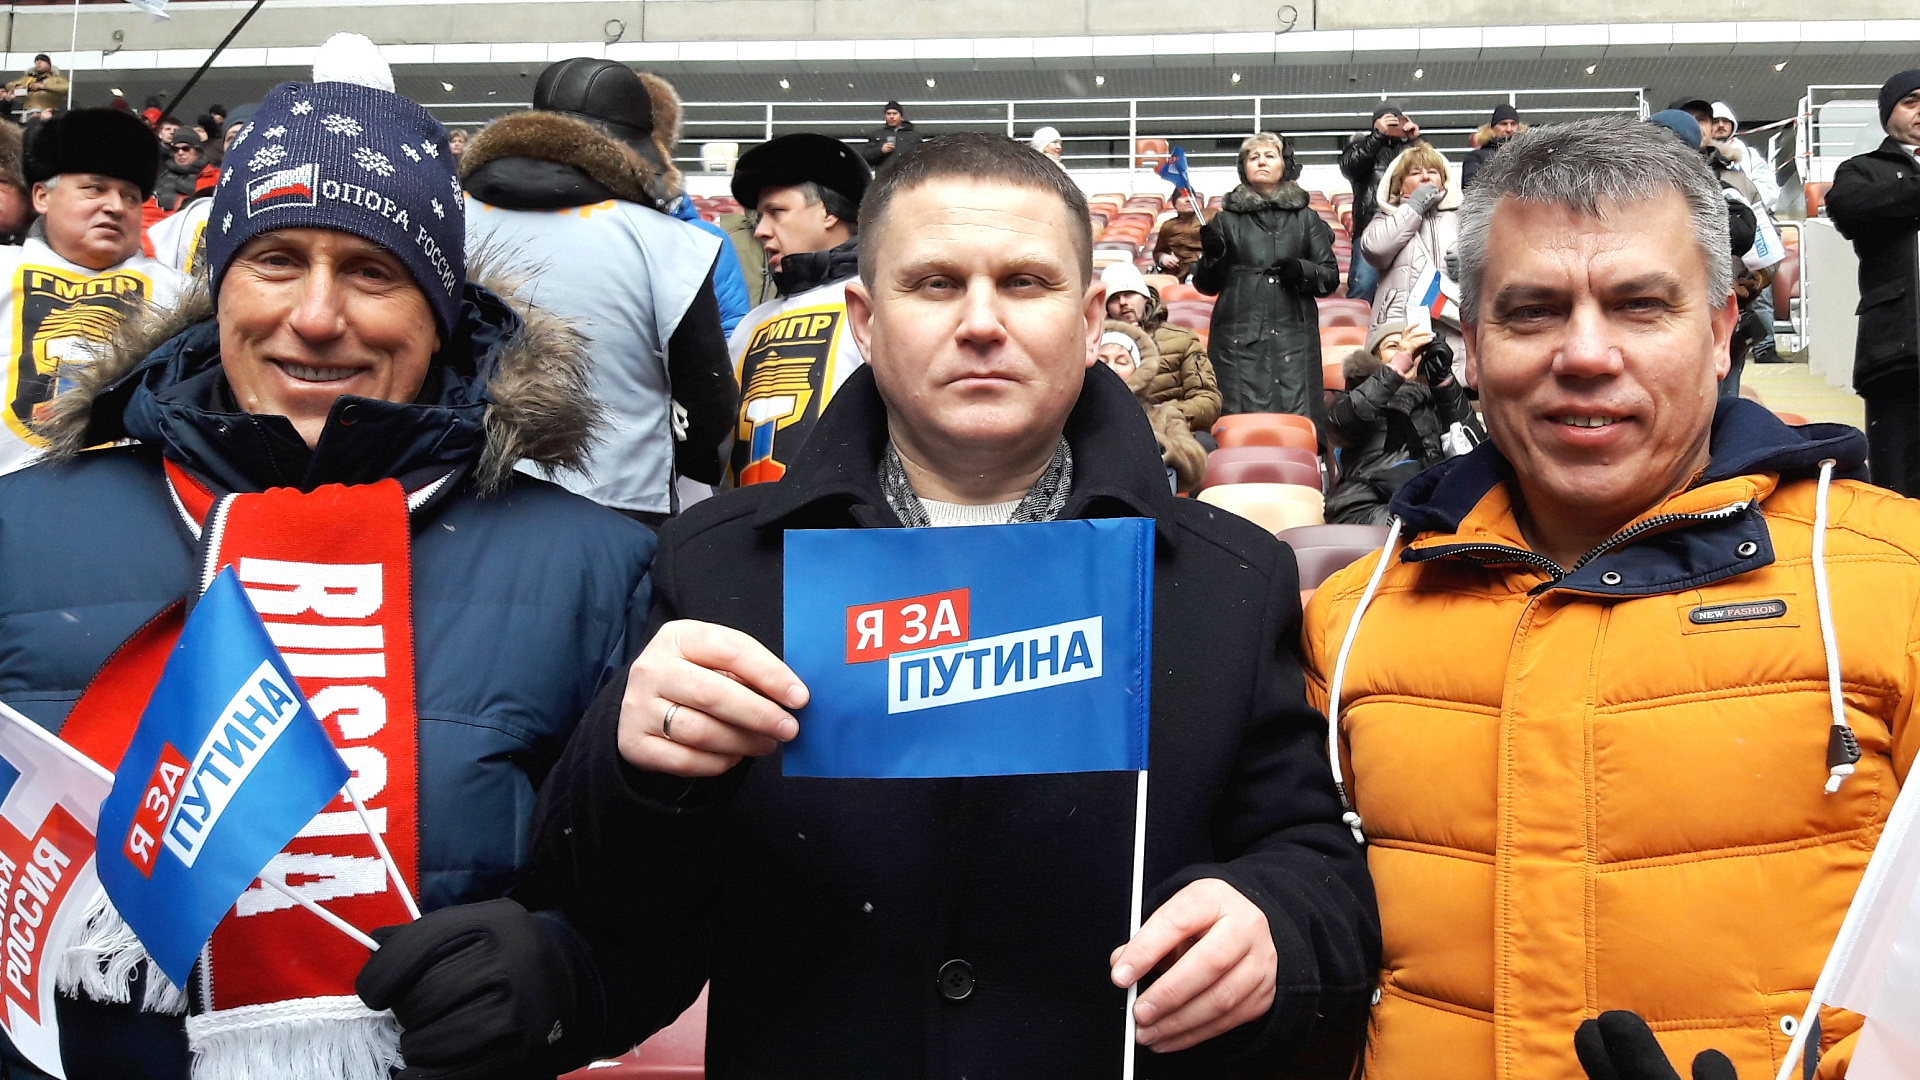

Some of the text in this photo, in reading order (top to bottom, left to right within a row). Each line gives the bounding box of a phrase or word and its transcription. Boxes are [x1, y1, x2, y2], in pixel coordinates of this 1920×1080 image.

[322, 179, 410, 232] ОПОРА
[414, 224, 457, 298] РОССИИ
[31, 272, 138, 299] ГМПР
[752, 315, 832, 349] ГМПР
[855, 599, 962, 650] Я ЗА
[1699, 605, 1776, 620] NEW FASHION
[899, 630, 1094, 702] ПУТИНА
[169, 678, 293, 853] ПУТИНА
[130, 761, 186, 864] Я ЗА
[6, 836, 72, 1000] РОССИЯ
